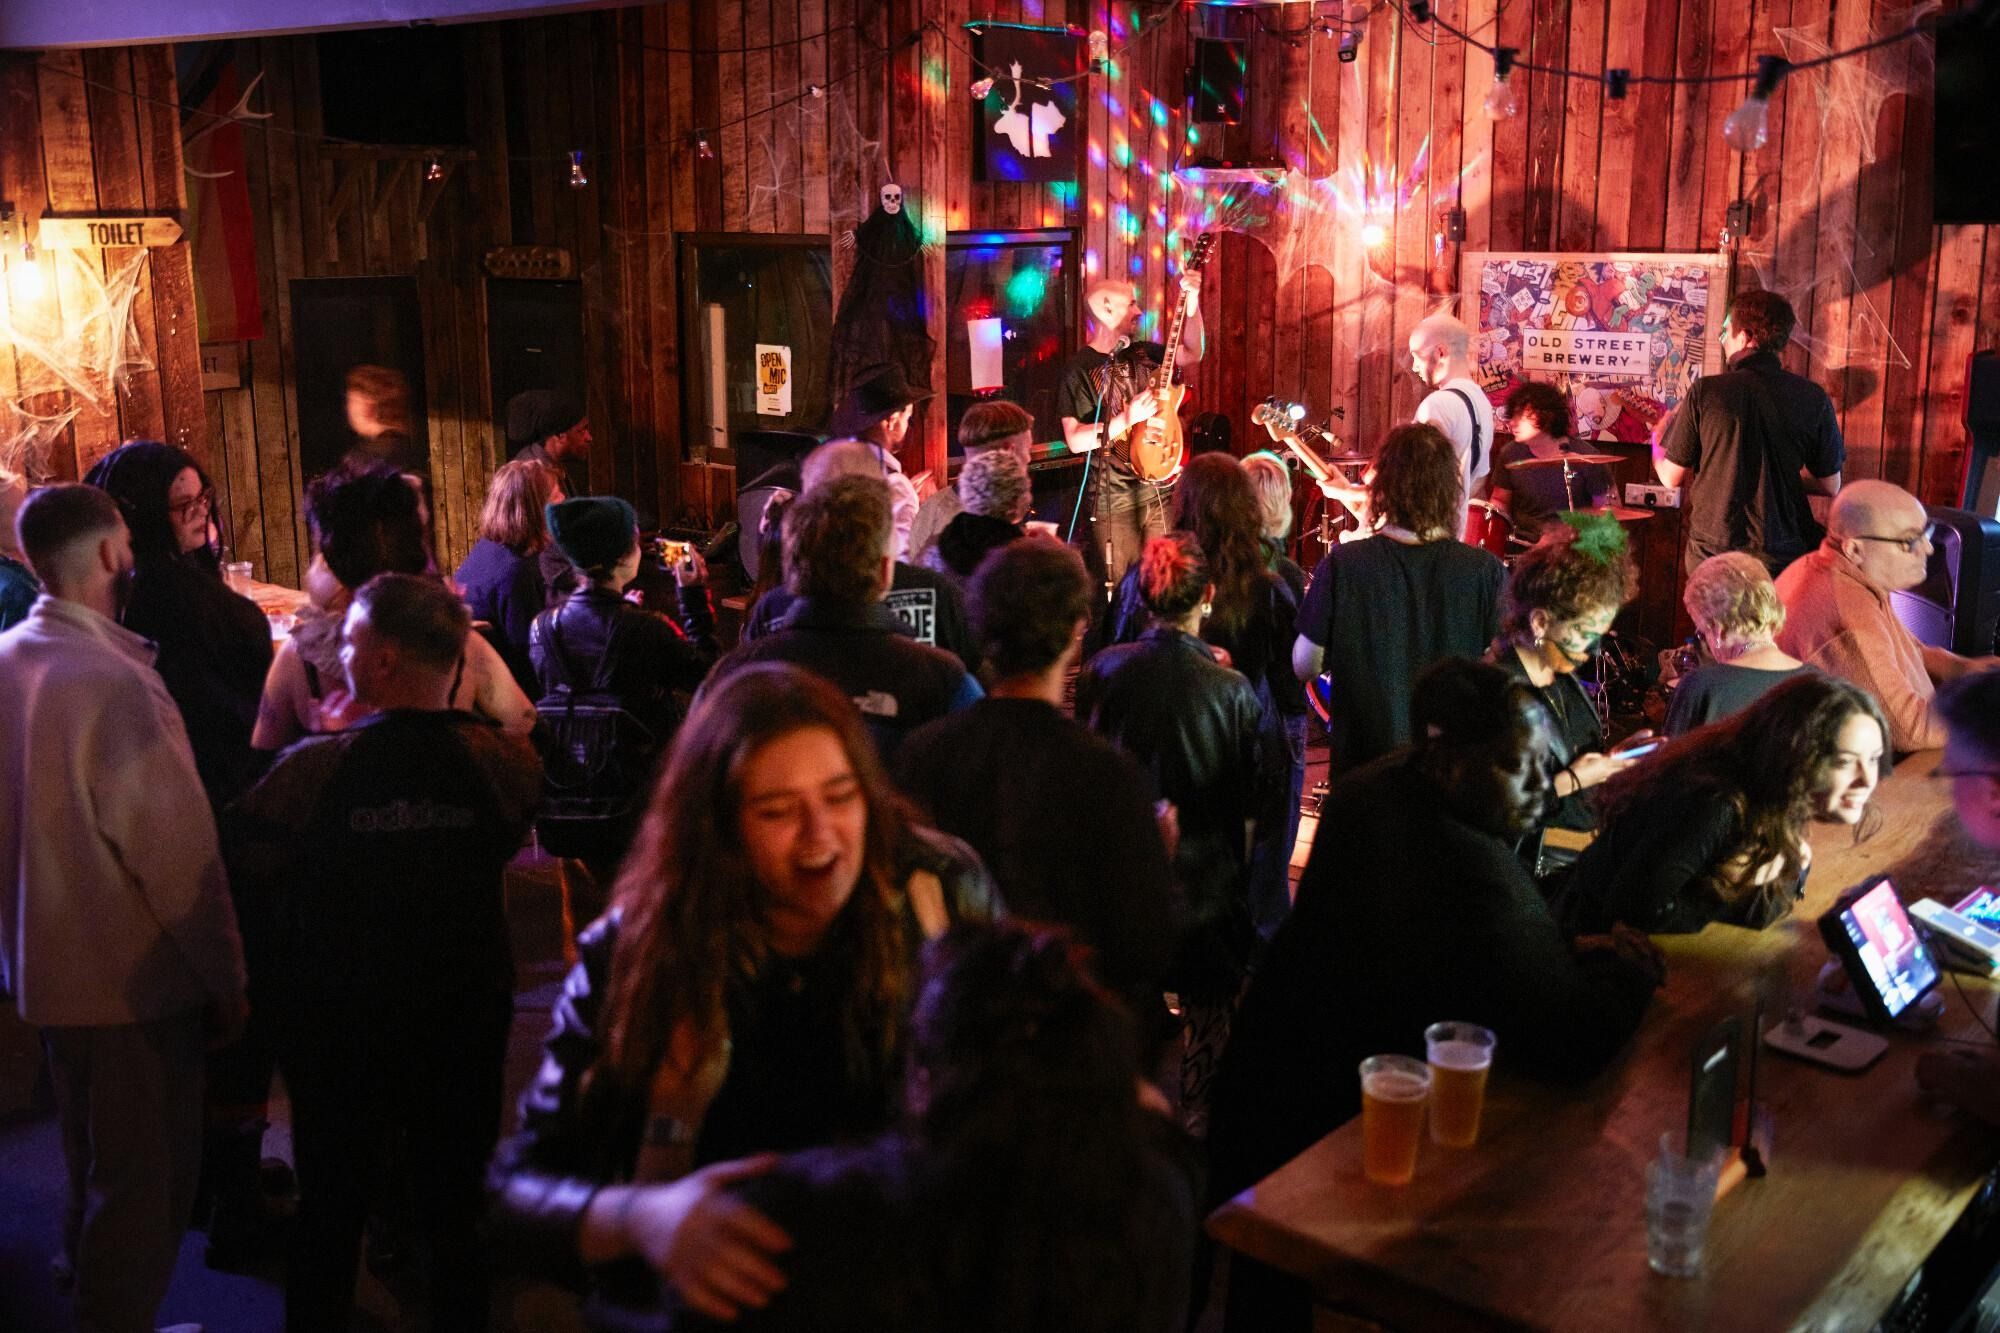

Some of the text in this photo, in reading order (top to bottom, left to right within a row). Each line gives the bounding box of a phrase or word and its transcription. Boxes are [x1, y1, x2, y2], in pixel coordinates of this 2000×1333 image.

[88, 222, 145, 245] TOILET
[1528, 336, 1562, 348] OLD
[1574, 338, 1646, 351] STREET
[760, 352, 782, 367] OPEN
[1543, 353, 1630, 367] BREWERY
[769, 367, 786, 385] MIC
